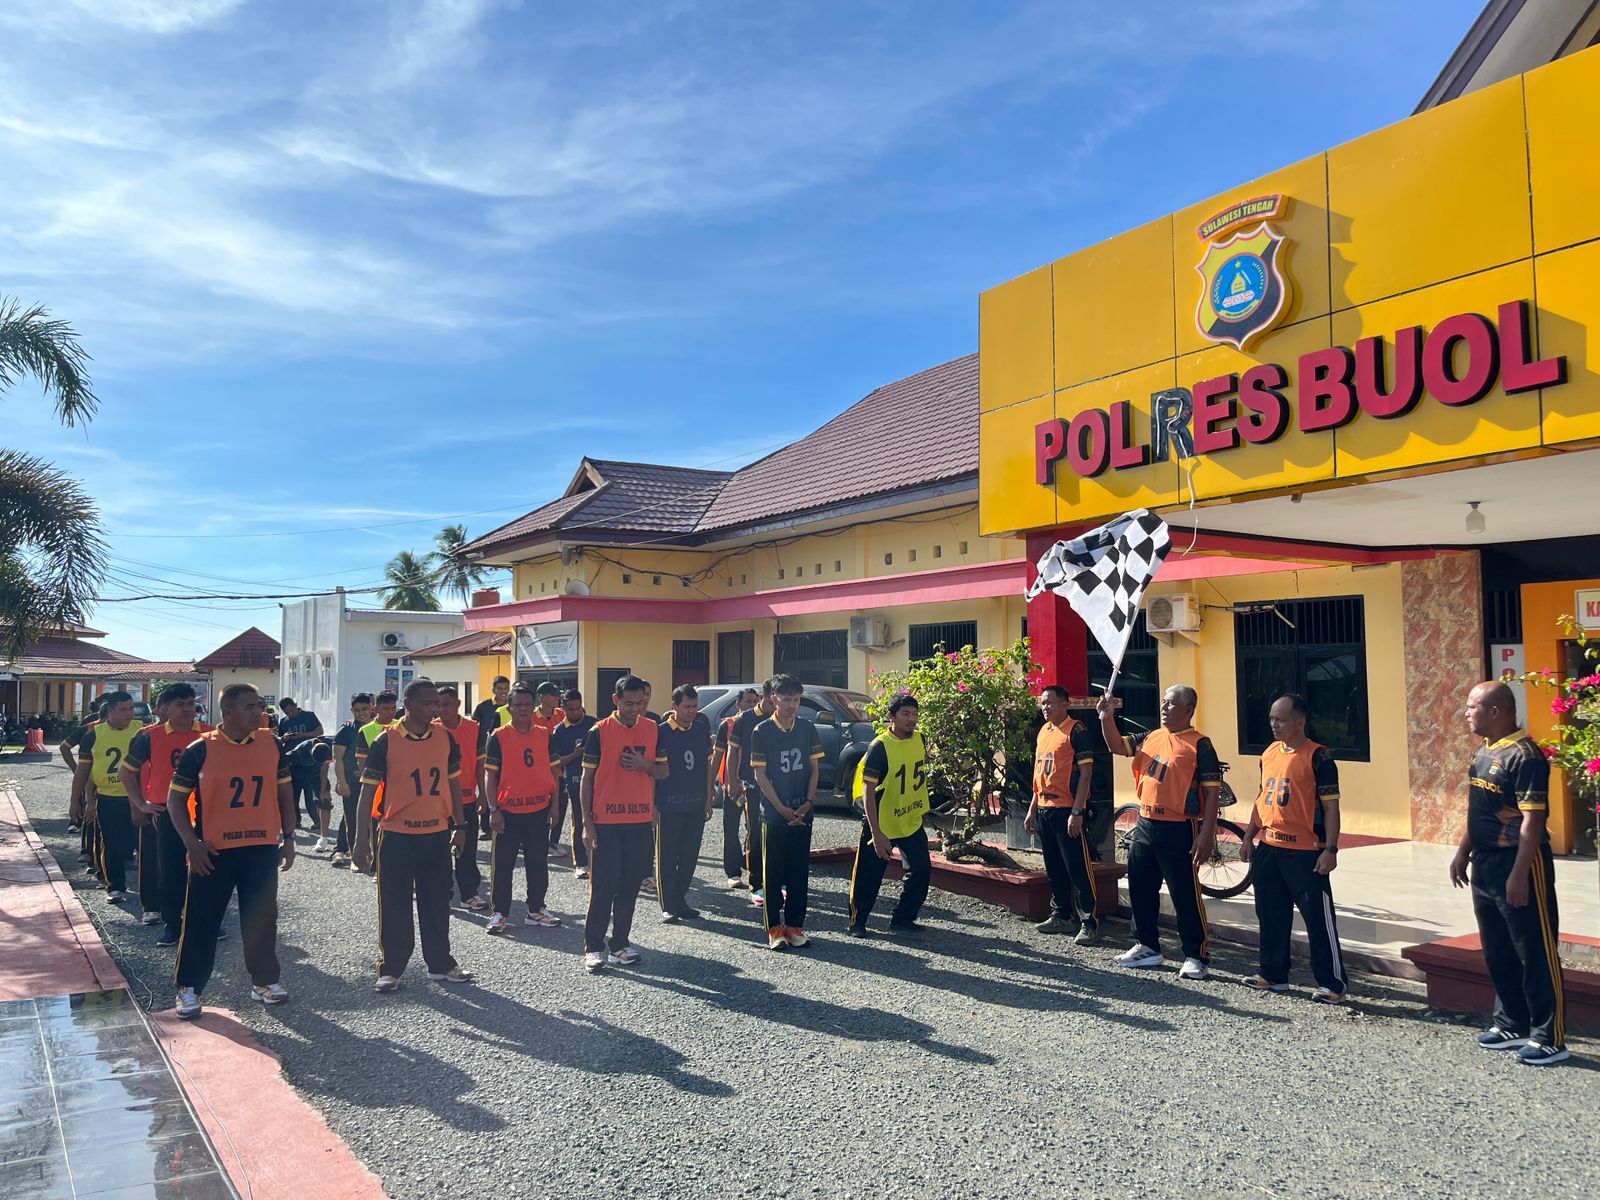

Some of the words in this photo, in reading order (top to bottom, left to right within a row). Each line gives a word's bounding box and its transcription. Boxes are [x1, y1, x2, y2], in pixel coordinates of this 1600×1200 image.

[1202, 209, 1242, 236] SULAWESI
[1242, 199, 1274, 217] TENGAH
[1034, 363, 1291, 486] POLRES
[1299, 298, 1568, 434] BUOL
[105, 746, 122, 775] 2
[523, 747, 534, 768] 6
[684, 750, 695, 770] 9
[780, 747, 804, 774] 52
[229, 775, 264, 809] 27
[409, 766, 441, 797] 12
[894, 759, 926, 796] 15
[1264, 776, 1291, 808] 25
[606, 803, 626, 815] POLDA
[627, 803, 651, 815] SULTENG
[222, 830, 244, 841] POLDA
[244, 829, 268, 839] SULTENG
